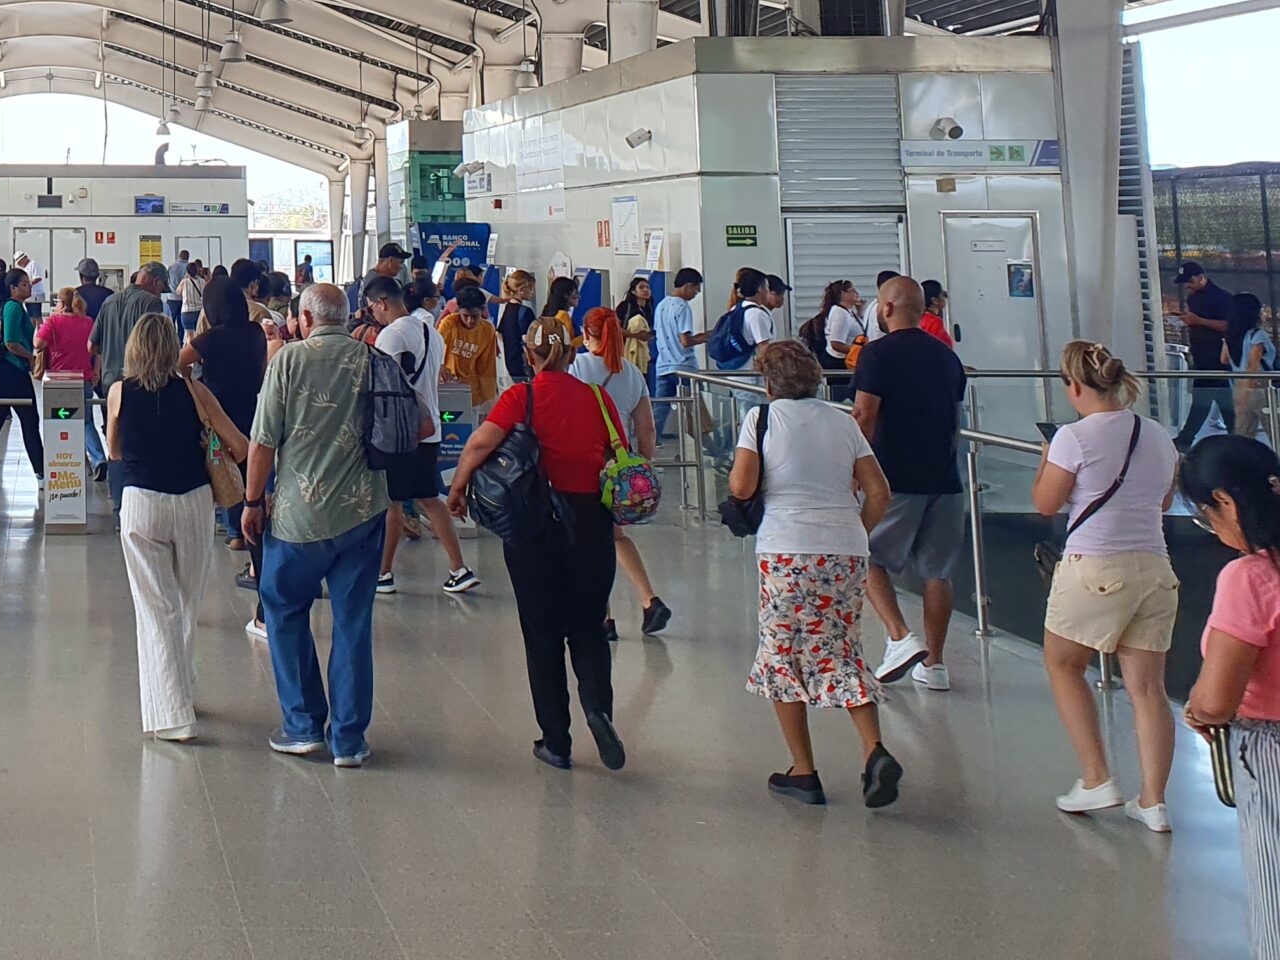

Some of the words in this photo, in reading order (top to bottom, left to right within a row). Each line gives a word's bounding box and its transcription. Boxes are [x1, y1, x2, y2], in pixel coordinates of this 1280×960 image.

[903, 149, 934, 157] Terminal
[936, 149, 945, 157] de
[947, 149, 983, 158] Transporte
[727, 226, 755, 234] SALIDA
[56, 452, 74, 460] HOY
